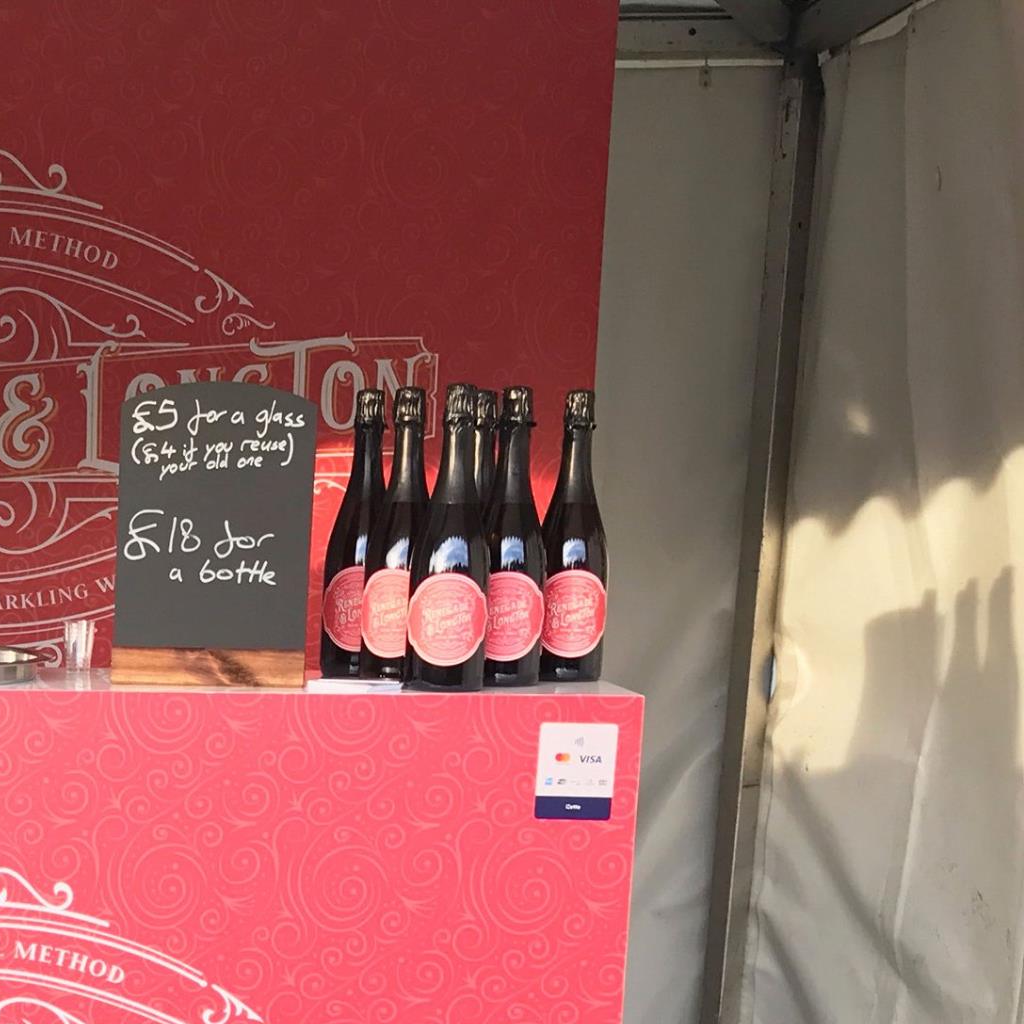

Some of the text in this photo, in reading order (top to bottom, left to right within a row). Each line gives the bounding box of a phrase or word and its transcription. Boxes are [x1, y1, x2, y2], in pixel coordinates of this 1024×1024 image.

[10, 226, 119, 270] METHOD
[132, 399, 306, 438] £5 for a glass
[182, 438, 198, 463] if
[203, 441, 233, 463] you
[159, 454, 264, 481] your old one
[124, 509, 275, 560] £18 for
[169, 559, 277, 586] a bottle
[579, 755, 603, 763] VISA
[14, 941, 126, 985] METHOD
